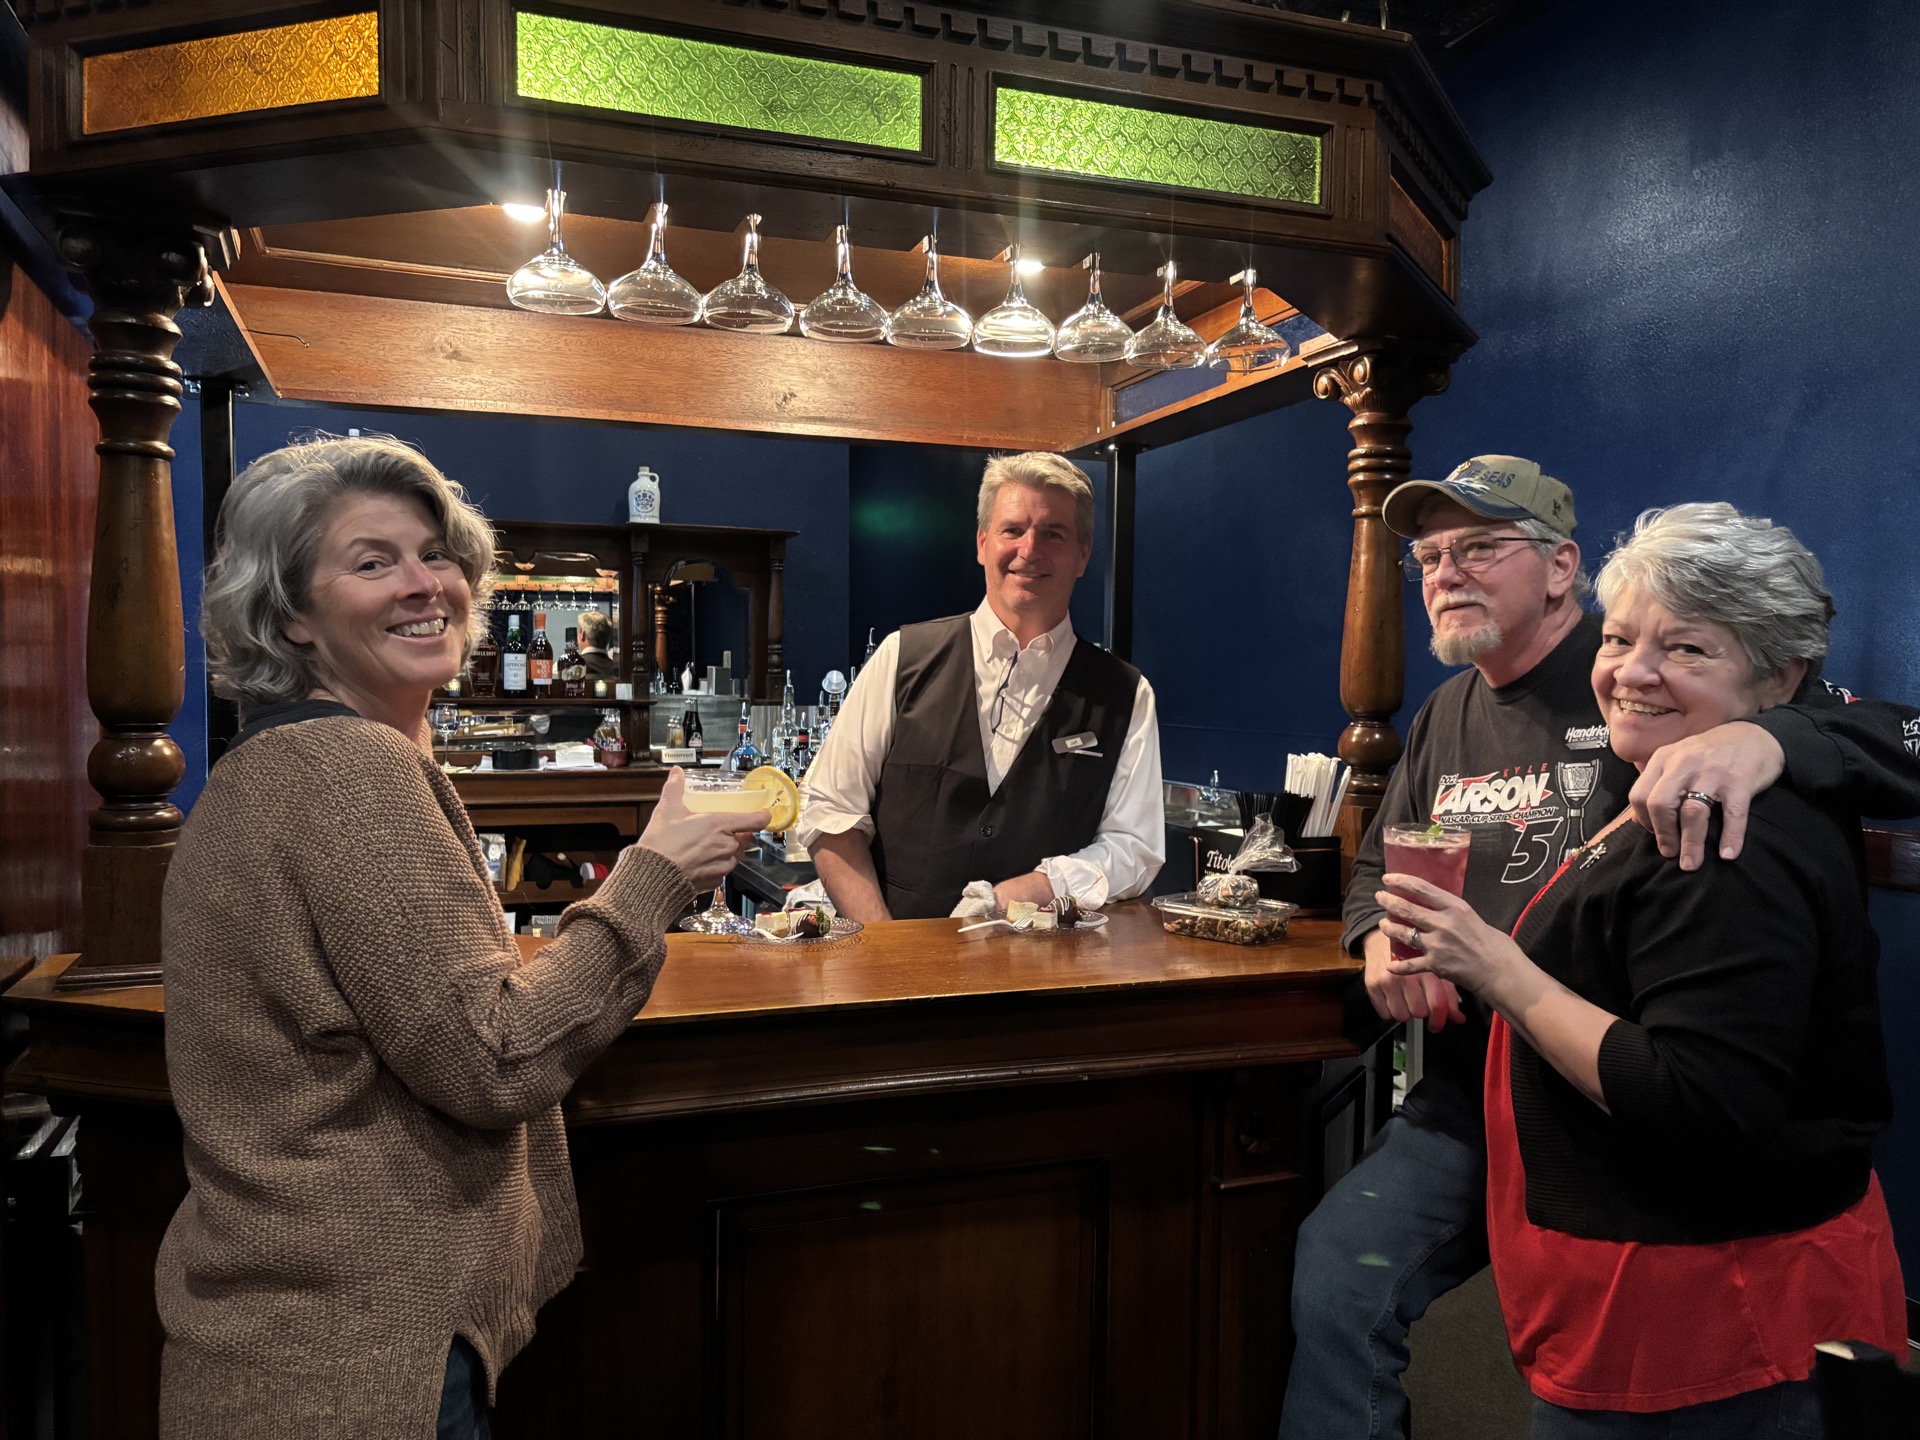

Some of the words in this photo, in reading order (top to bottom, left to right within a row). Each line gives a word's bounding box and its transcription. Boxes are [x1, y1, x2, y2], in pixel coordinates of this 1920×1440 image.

[1481, 470, 1515, 489] SEAS
[1565, 725, 1609, 742] Hendrick
[1503, 763, 1548, 778] KYLE
[1432, 772, 1550, 815] LARSON
[1440, 815, 1470, 824] NASCAR
[1471, 814, 1490, 823] CUP
[1490, 813, 1512, 823] SERIES
[1513, 807, 1556, 820] CHAMPION
[1501, 817, 1563, 883] 5
